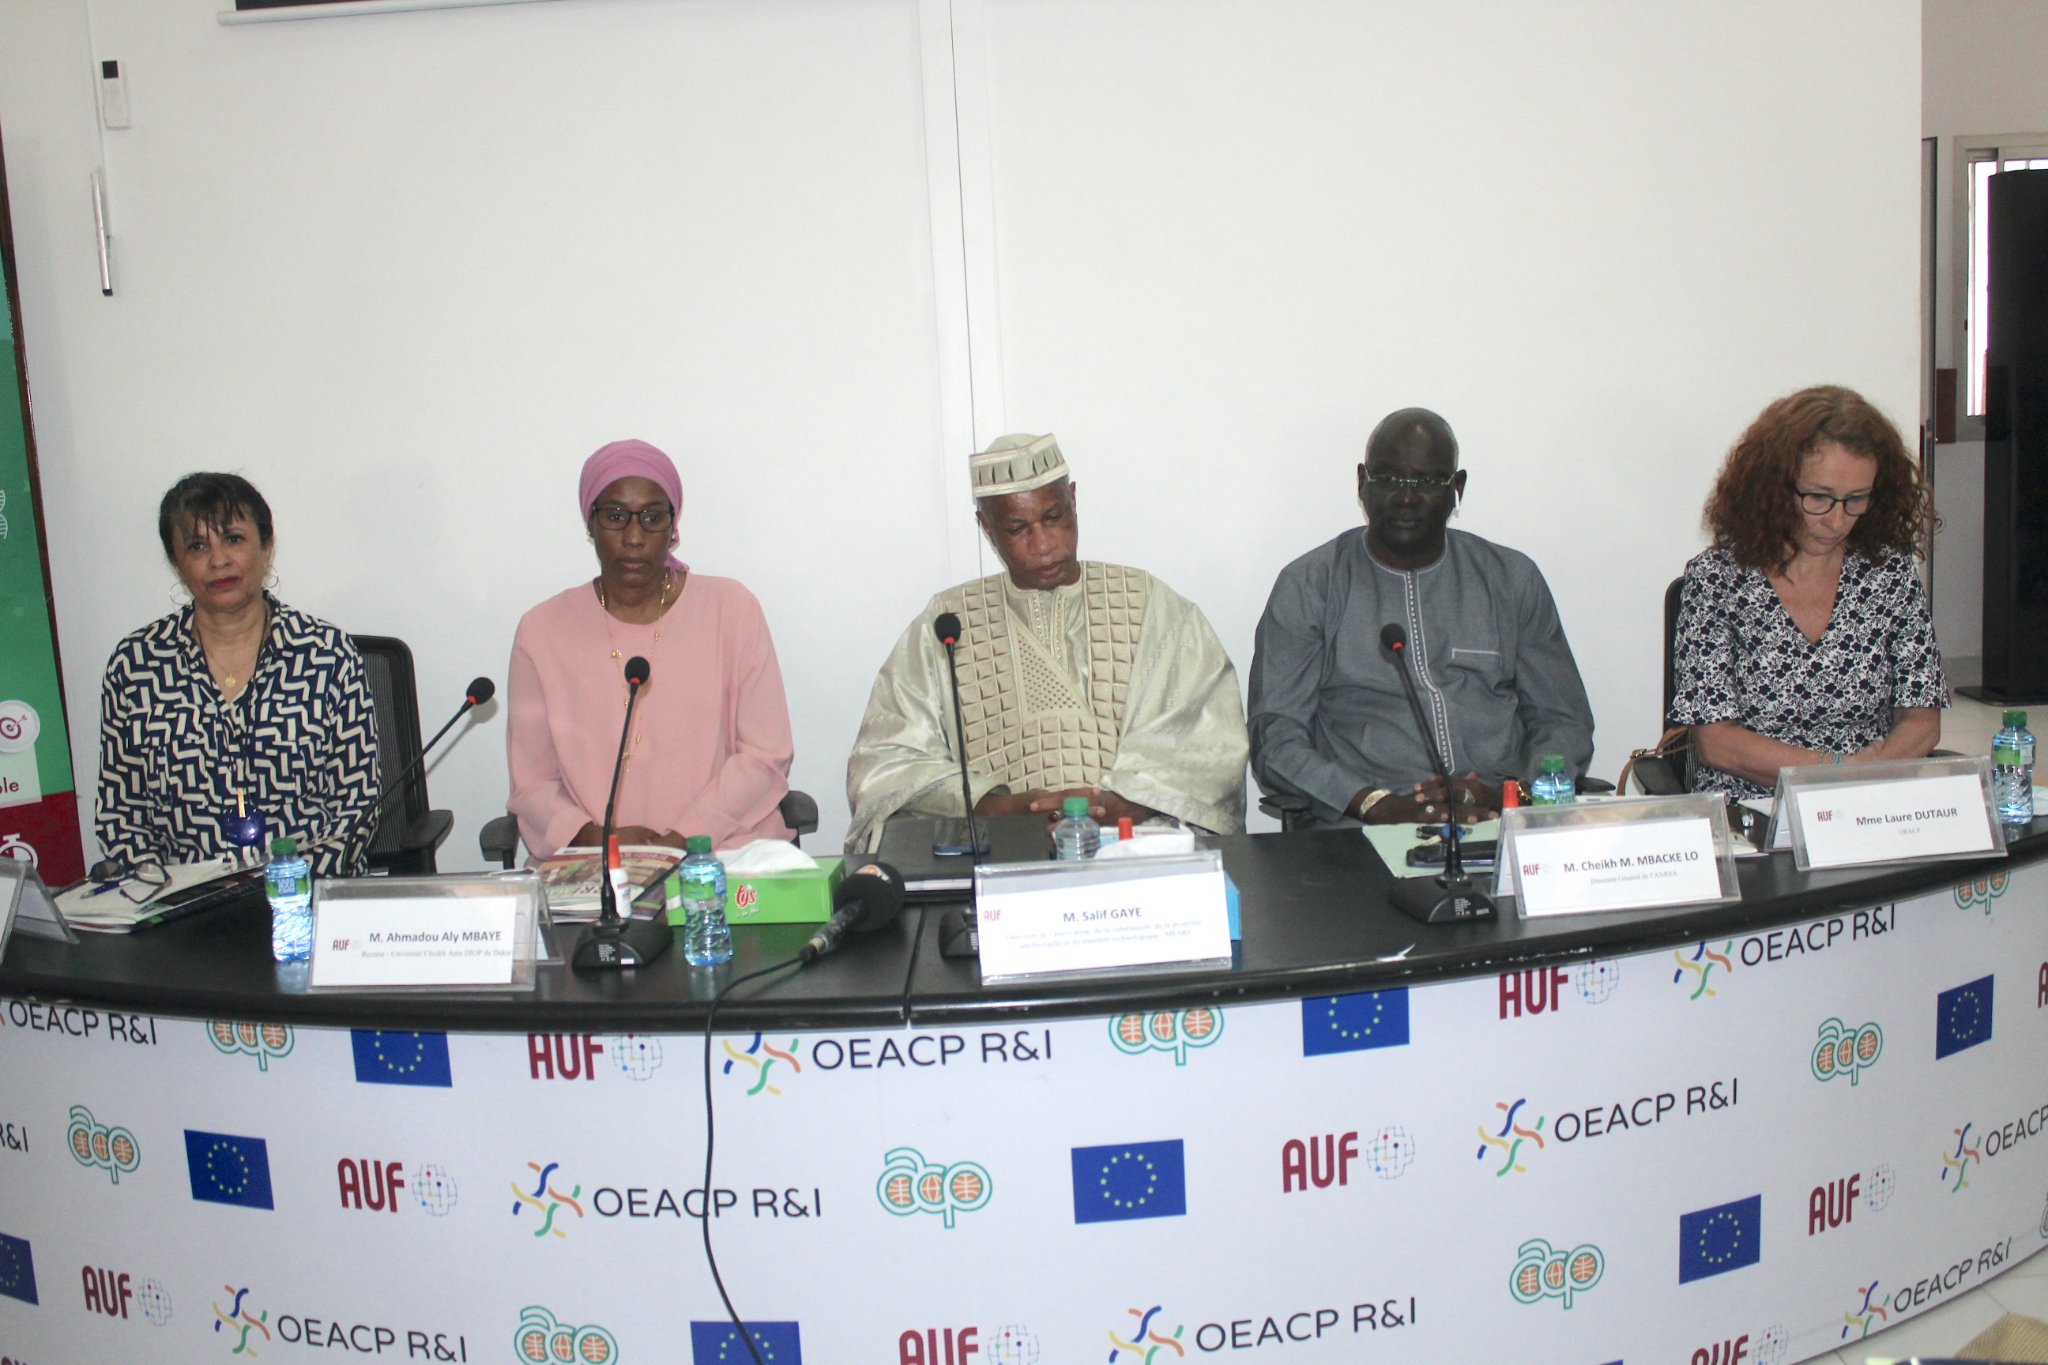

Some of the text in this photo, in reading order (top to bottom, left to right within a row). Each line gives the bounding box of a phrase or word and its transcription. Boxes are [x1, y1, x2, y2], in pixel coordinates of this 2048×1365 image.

[1817, 810, 1833, 822] AUF
[1856, 808, 1958, 826] Mme Laure DUTAUR
[1522, 863, 1540, 876] AUF
[1563, 850, 1699, 873] M. Cheikh M. MBACKE LO
[369, 930, 501, 944] M. Ahmadou Aly MBAYE
[983, 909, 1001, 922] AUF
[1063, 907, 1142, 923] M. Salif GAYE
[1741, 904, 1896, 966] OEACP R&I
[332, 938, 350, 951] AUF
[1499, 965, 1568, 1020] AUF
[9, 1002, 158, 1045] OEACP R&I
[528, 1032, 604, 1080] AUF
[813, 1029, 1051, 1069] OEACP R&I
[1555, 1077, 1738, 1143] OEACP R&I
[1281, 1131, 1358, 1193] AUF
[338, 1157, 405, 1213] AUF
[593, 1187, 821, 1218] OEACP R&I
[1808, 1173, 1860, 1235] AUF
[83, 1265, 132, 1319] AUF
[1894, 1236, 2013, 1313] OEACP R&I
[277, 1315, 467, 1363] OEACP R&I
[1197, 1296, 1416, 1352] OEACP R&I
